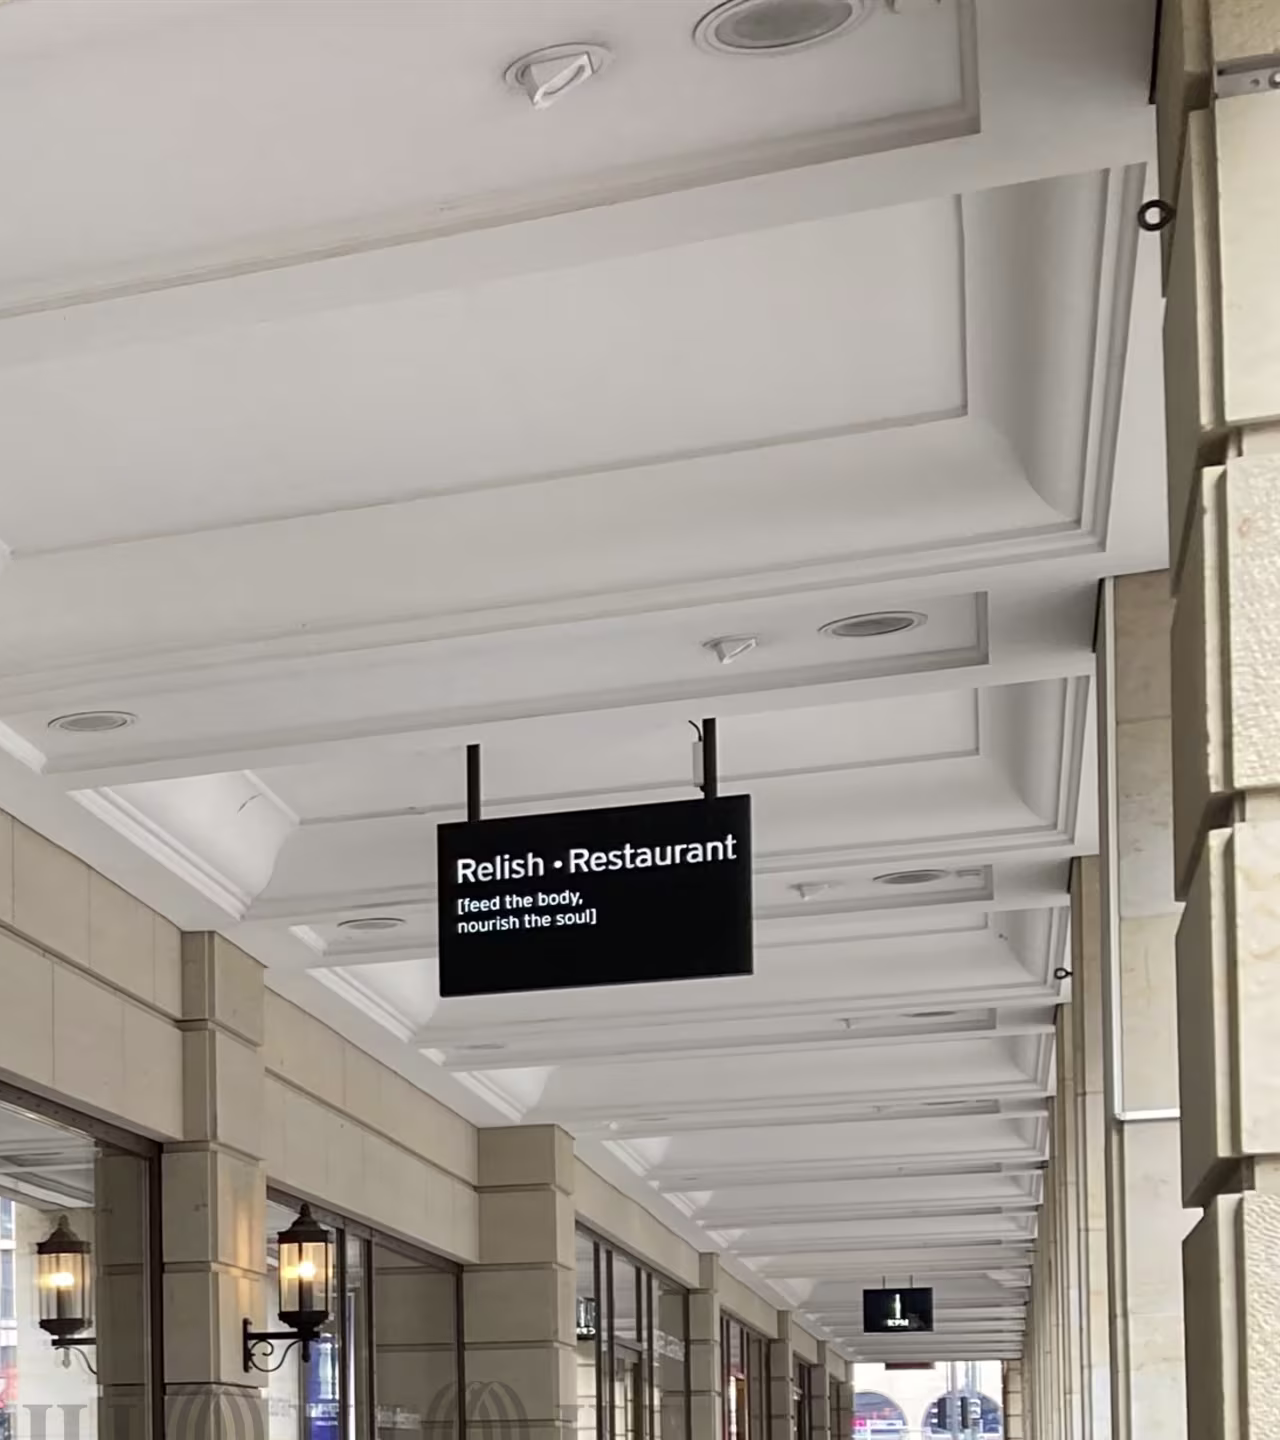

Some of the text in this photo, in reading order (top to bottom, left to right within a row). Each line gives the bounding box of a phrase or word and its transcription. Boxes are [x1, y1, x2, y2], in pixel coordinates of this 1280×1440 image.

[457, 833, 737, 884] Relish Restaurant
[458, 890, 583, 915] [feed the body,
[458, 908, 597, 934] nourish the soul]
